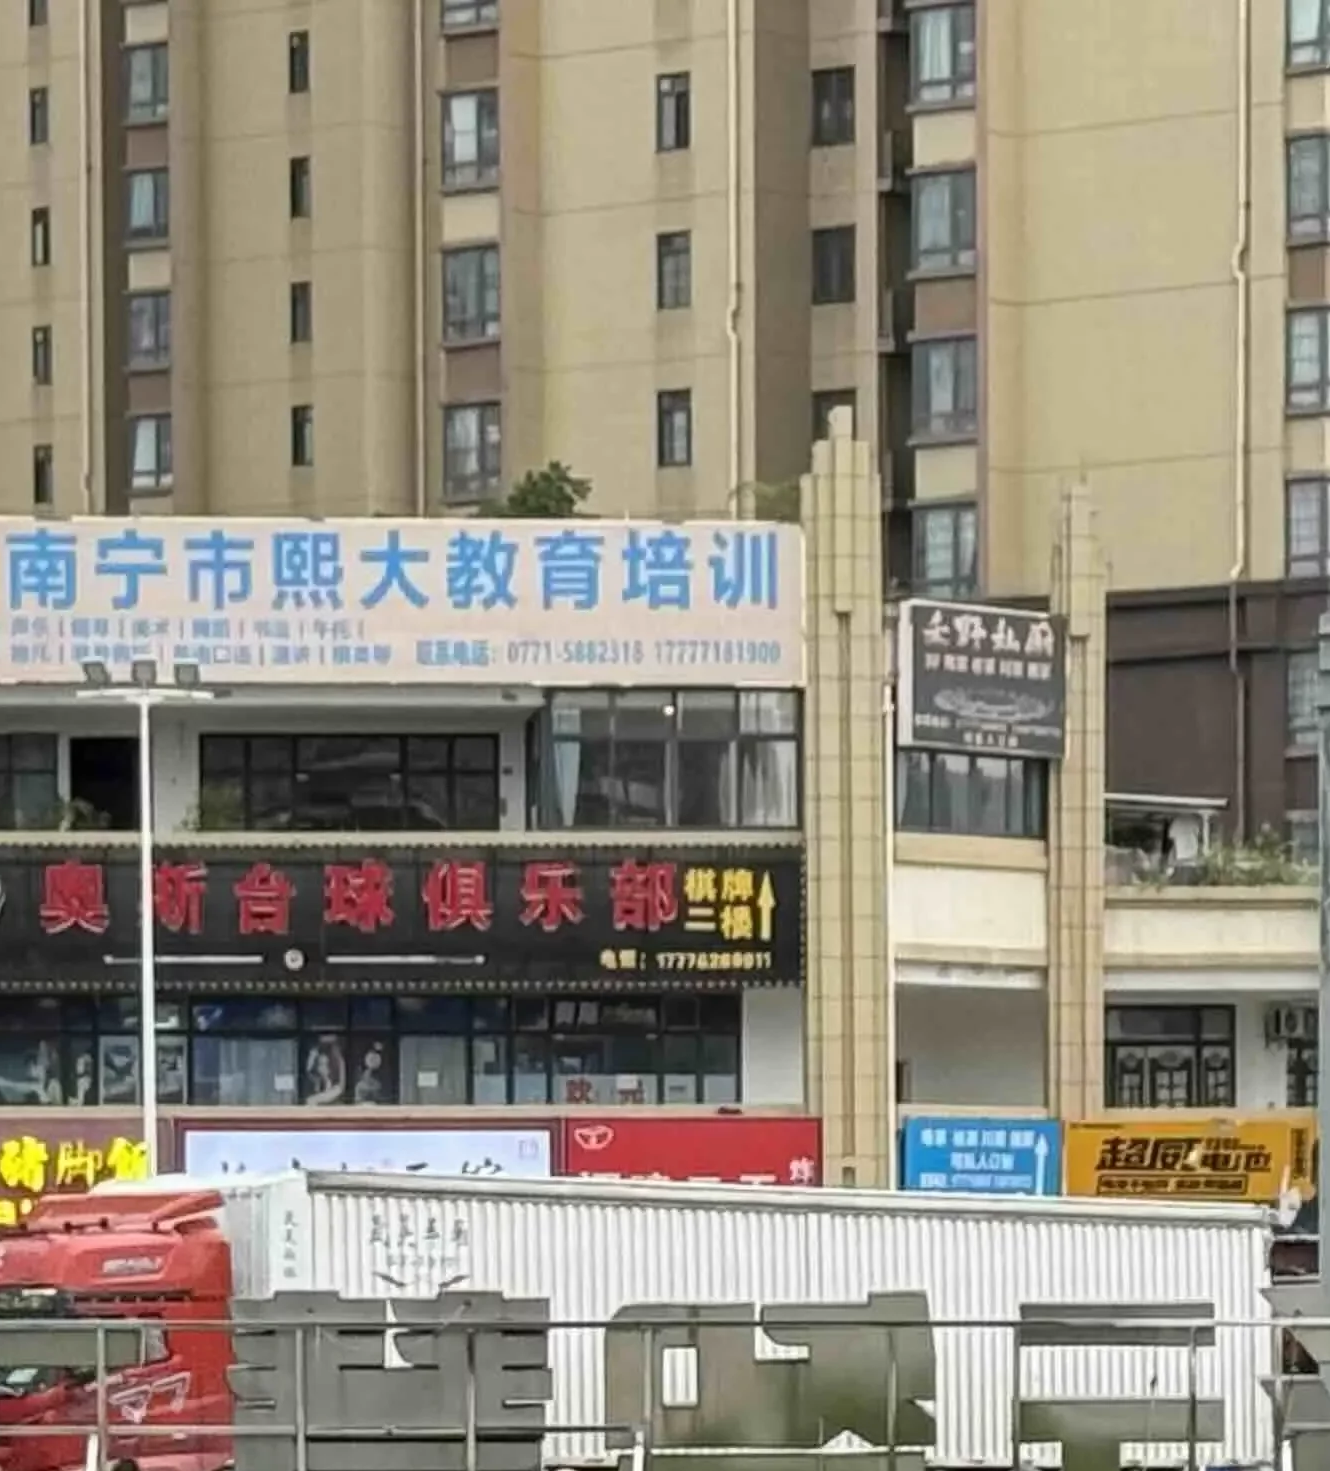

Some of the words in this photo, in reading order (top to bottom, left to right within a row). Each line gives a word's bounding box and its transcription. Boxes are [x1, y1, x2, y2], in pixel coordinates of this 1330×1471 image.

[5, 527, 779, 611] 南宁市熙大教育培训
